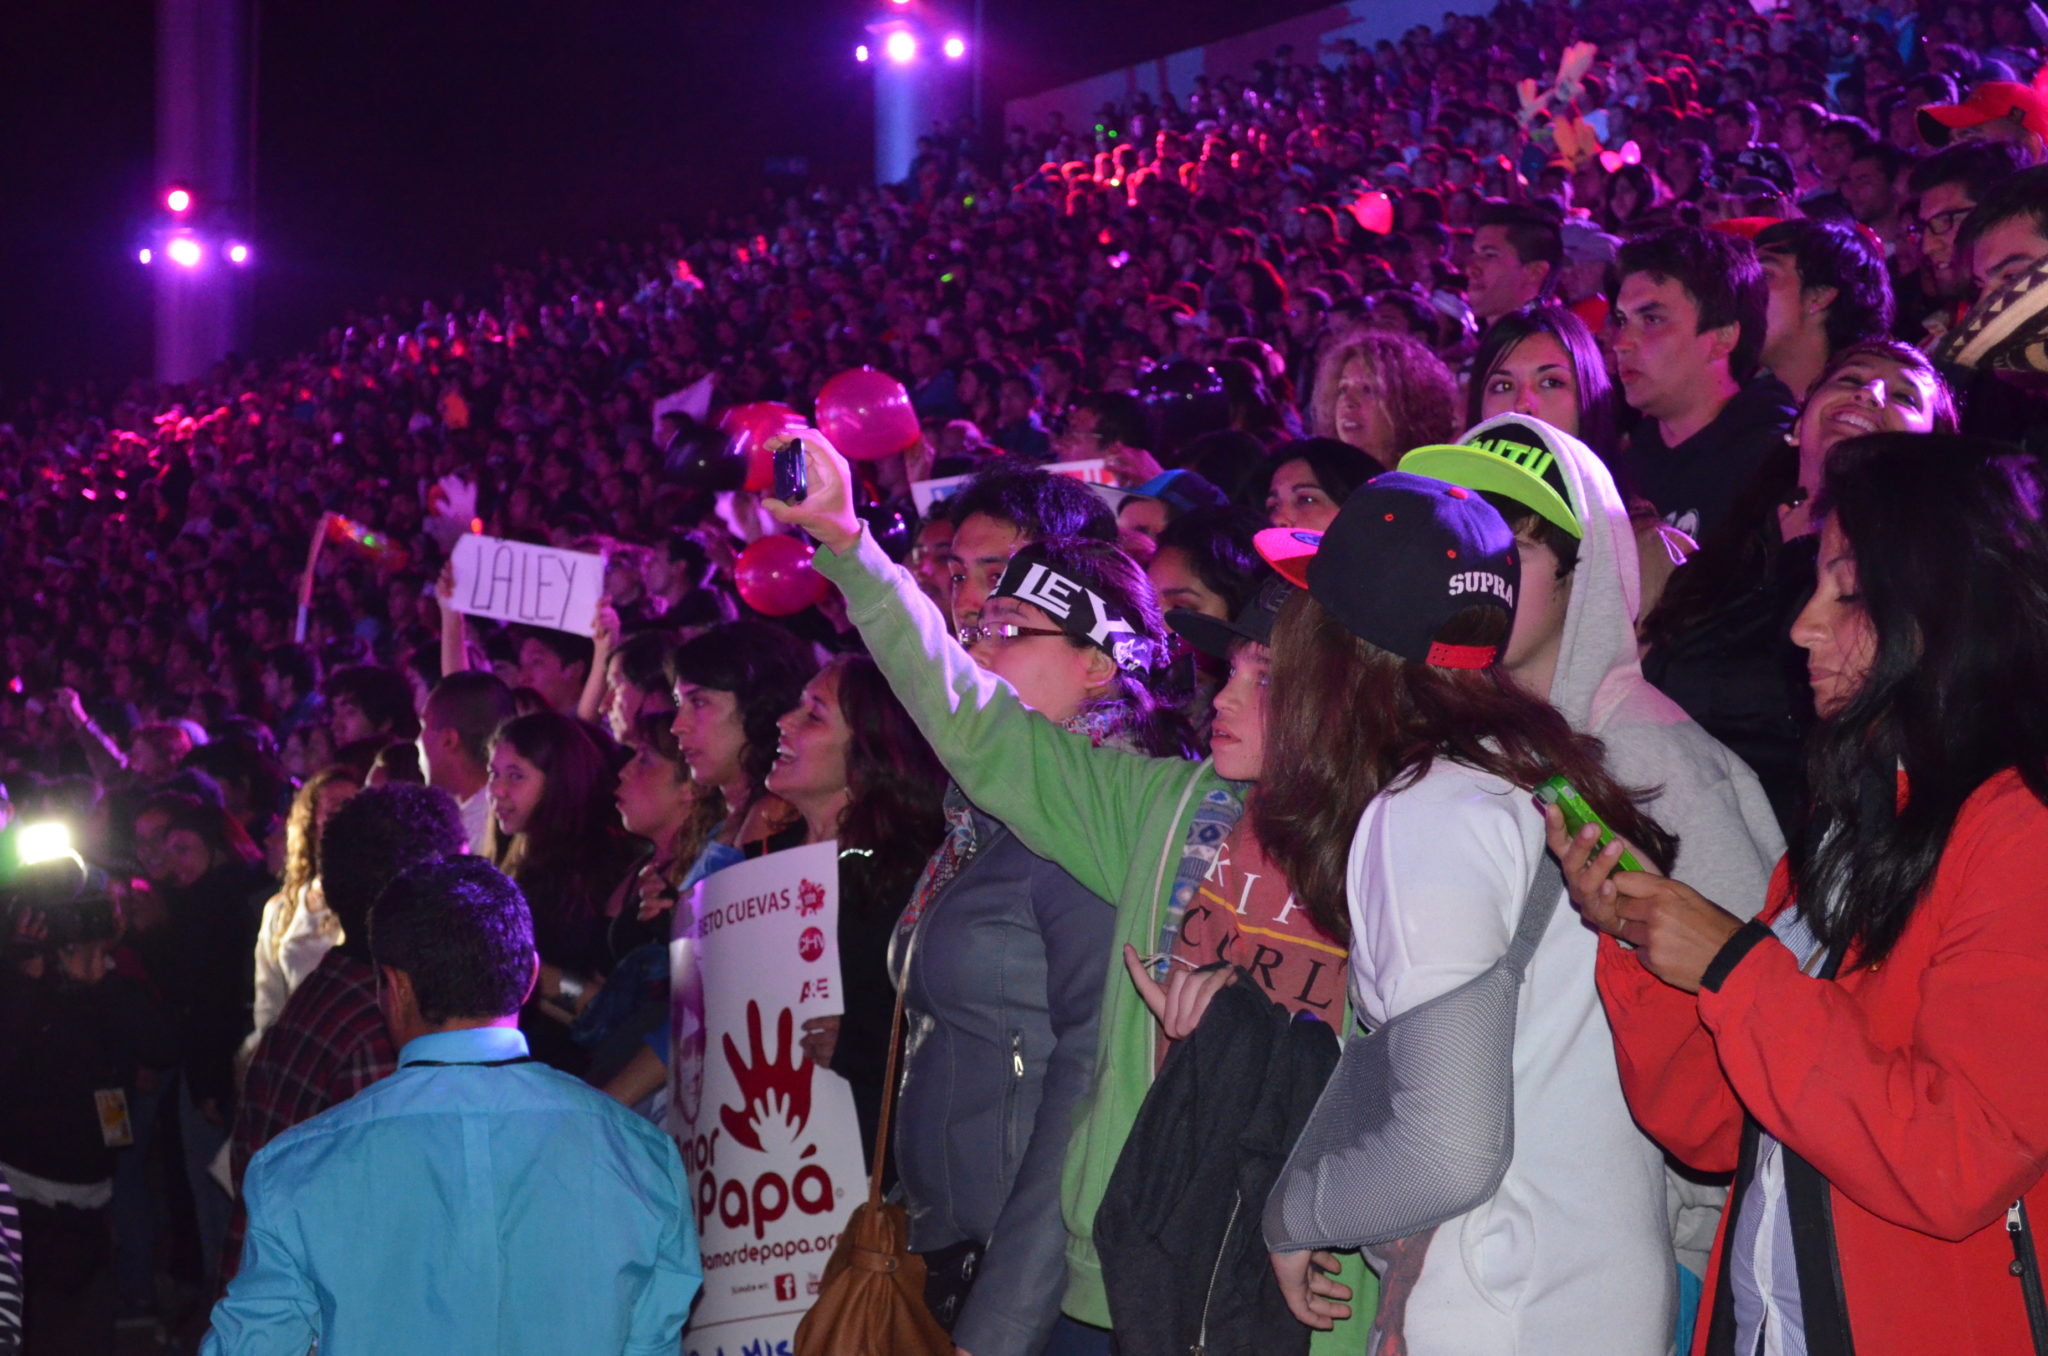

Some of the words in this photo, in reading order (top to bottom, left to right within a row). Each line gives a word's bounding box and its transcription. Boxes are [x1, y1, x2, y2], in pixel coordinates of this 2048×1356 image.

[1012, 562, 1136, 646] LEY
[1449, 571, 1513, 609] SUPRA
[727, 888, 790, 925] CUEVAS
[676, 1127, 720, 1174] mor
[698, 1143, 835, 1240] papá
[700, 1233, 841, 1270] amordepapa.or
